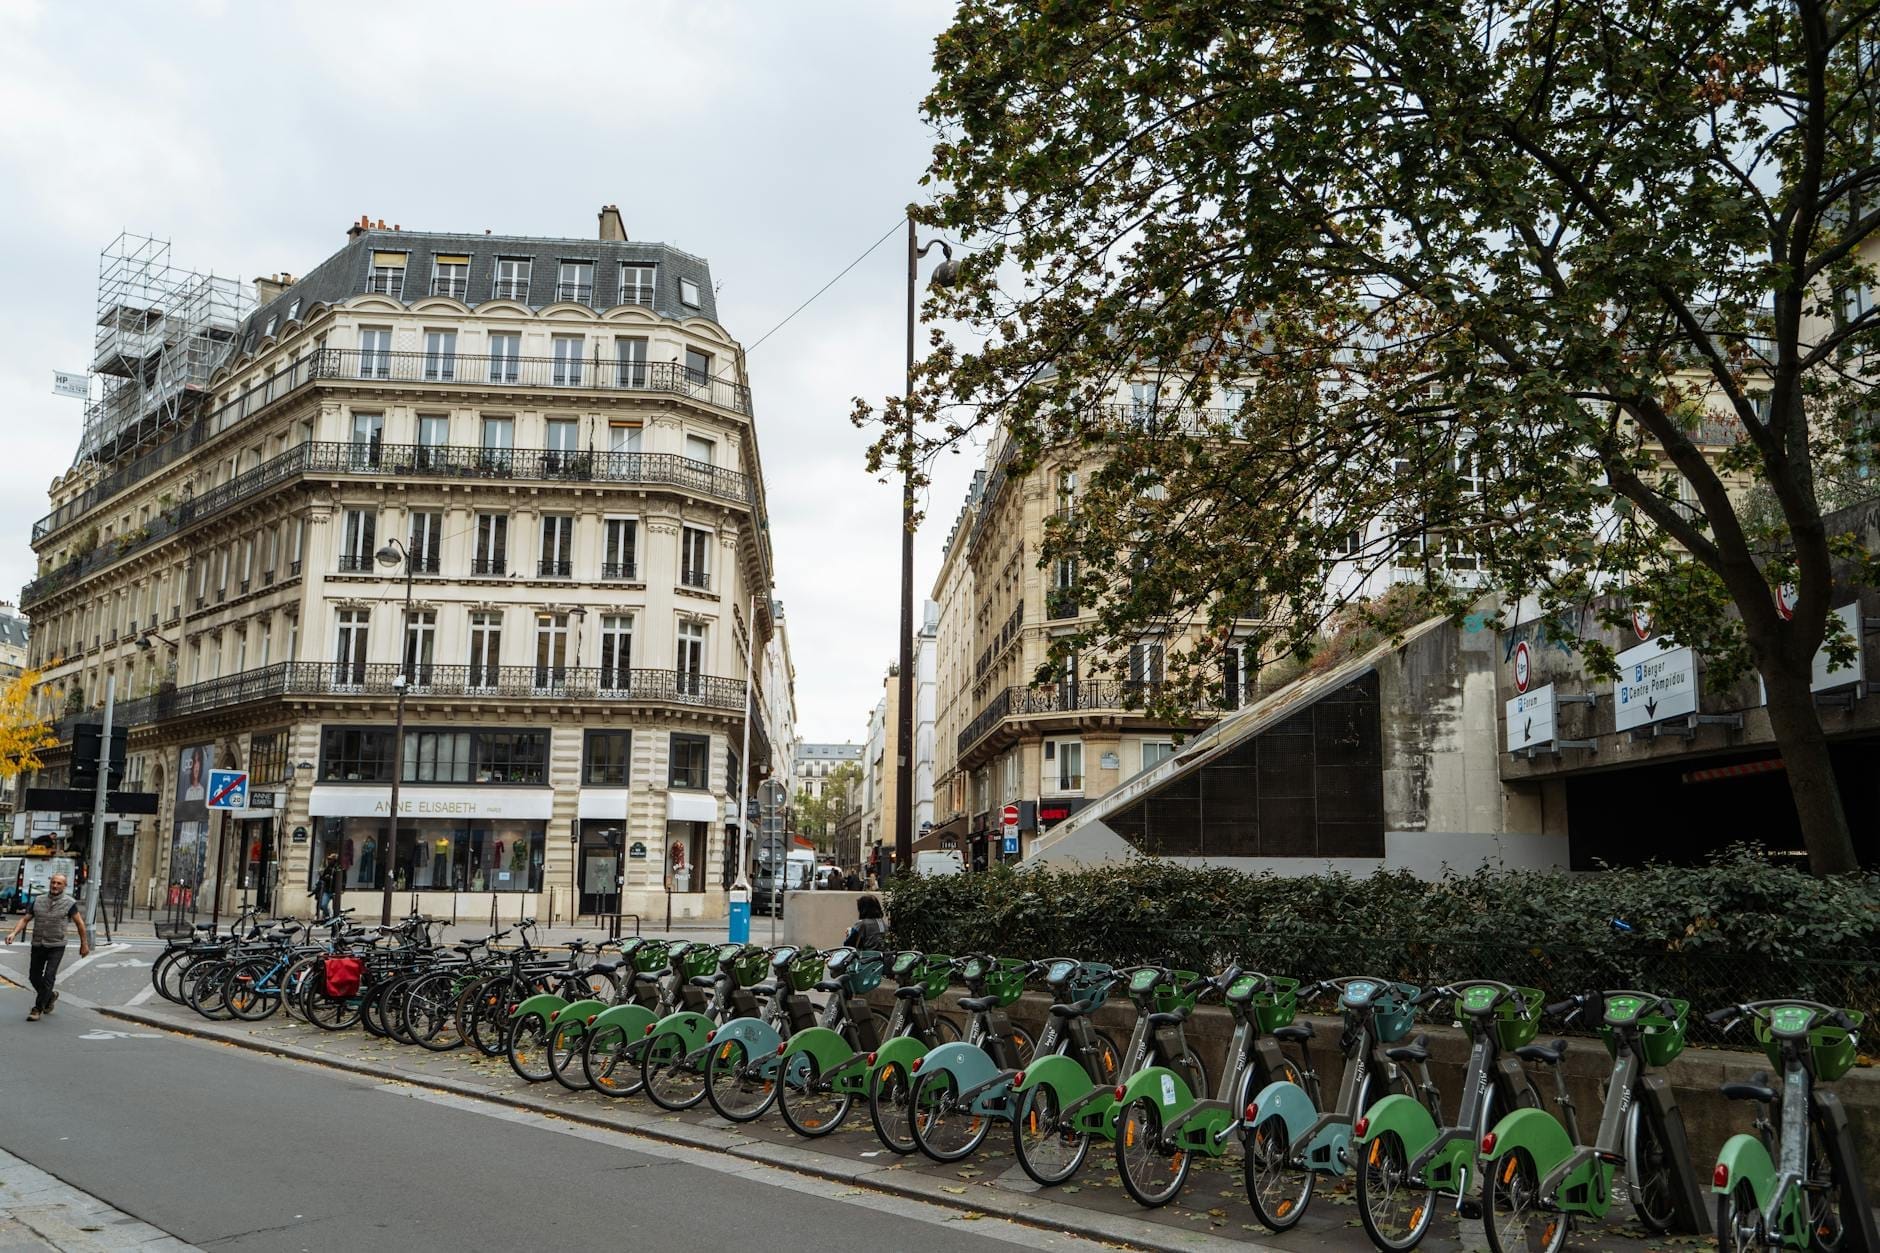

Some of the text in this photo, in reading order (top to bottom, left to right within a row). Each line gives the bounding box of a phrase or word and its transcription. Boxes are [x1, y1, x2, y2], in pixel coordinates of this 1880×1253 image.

[56, 375, 68, 383] HP
[1643, 662, 1665, 677] Berger
[1629, 684, 1649, 699] Centre
[1651, 672, 1685, 692] Pompidou
[1523, 697, 1538, 708] Forum
[374, 801, 413, 813] ANNE
[419, 802, 477, 814] ELISABETH
